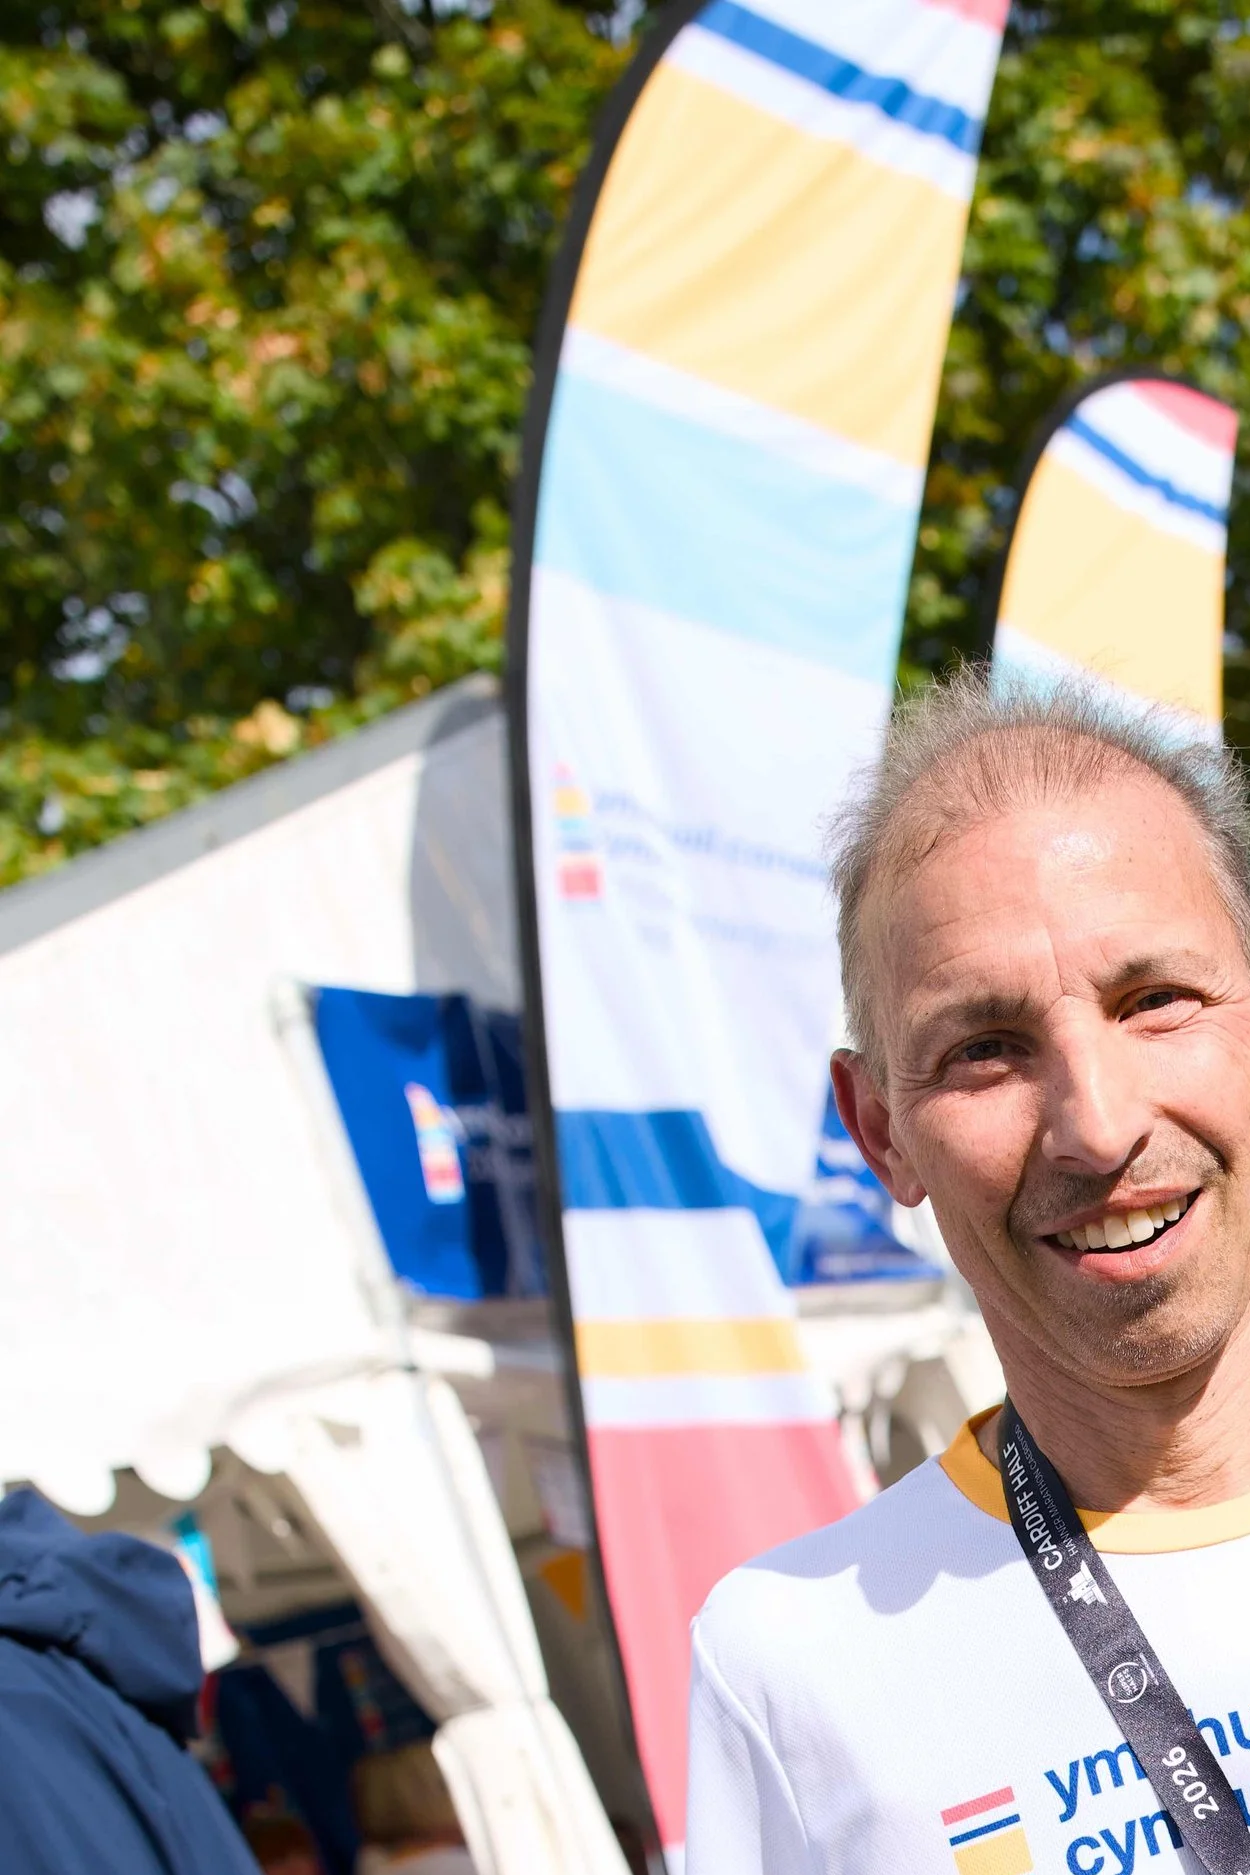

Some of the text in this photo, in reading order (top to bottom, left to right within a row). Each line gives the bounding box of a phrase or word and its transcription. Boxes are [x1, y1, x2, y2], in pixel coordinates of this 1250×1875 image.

[1000, 1440, 1065, 1572] CARDIFF HALF
[1031, 1467, 1059, 1518] MARATHON
[1051, 1515, 1079, 1557] HANNER
[1161, 1745, 1220, 1821] 2026
